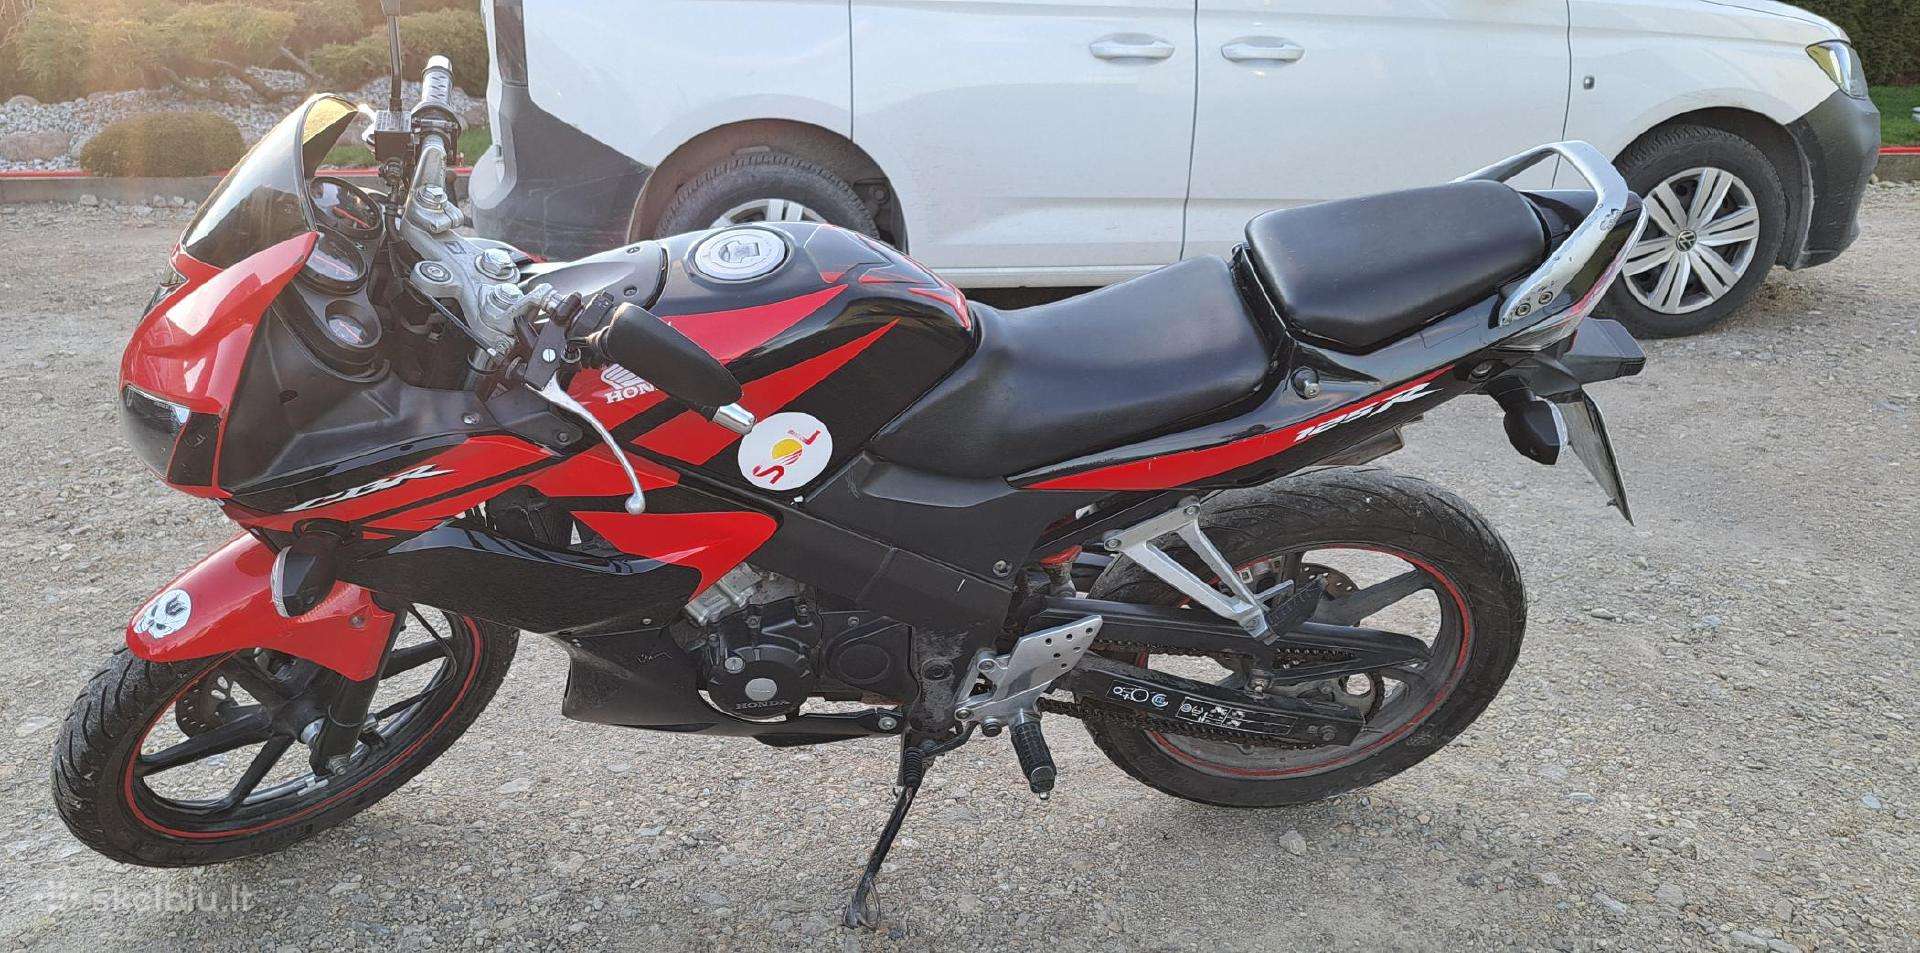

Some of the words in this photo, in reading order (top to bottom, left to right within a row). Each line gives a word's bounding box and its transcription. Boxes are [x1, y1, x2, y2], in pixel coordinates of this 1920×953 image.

[604, 383, 656, 404] HON
[283, 464, 454, 512] CBR
[735, 700, 790, 710] HONDA
